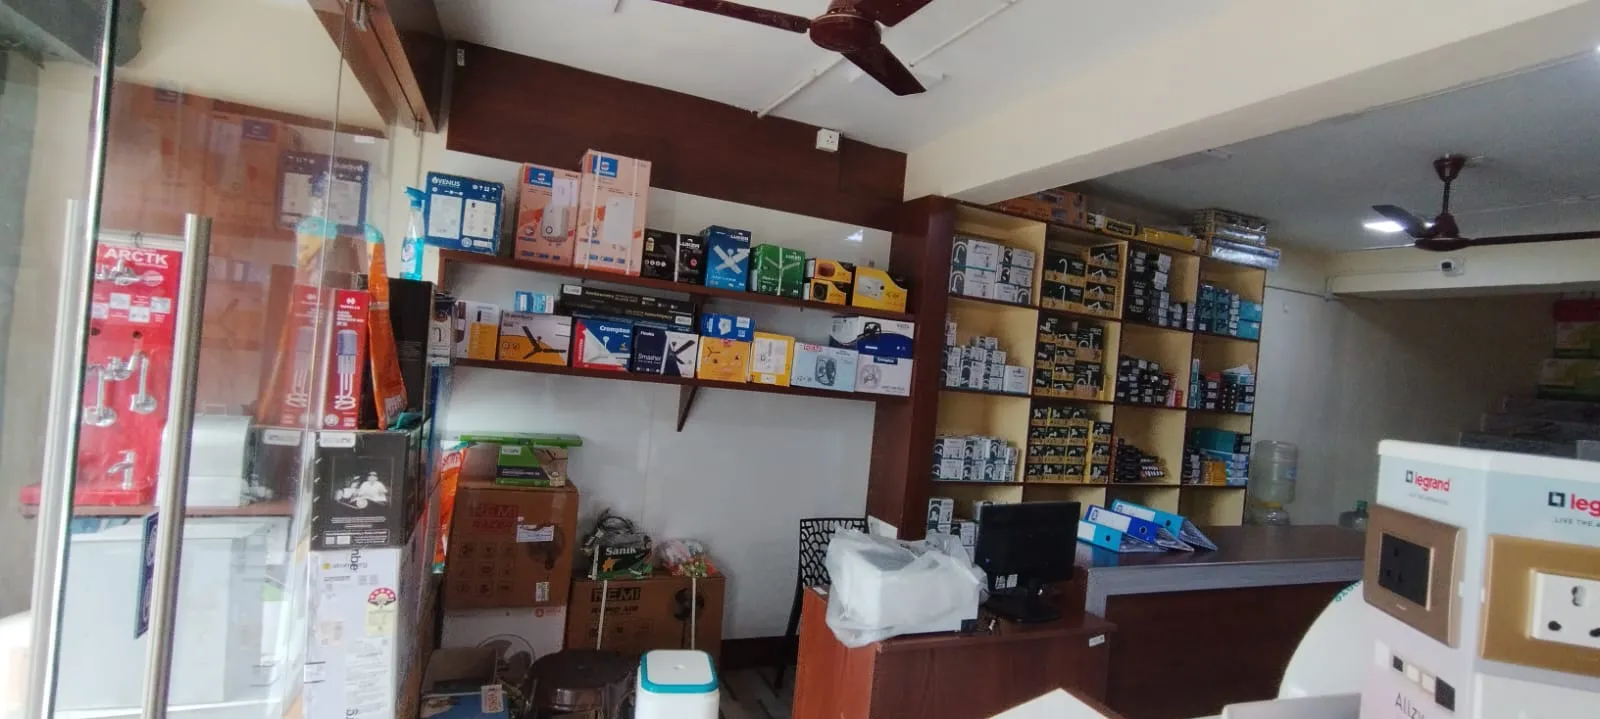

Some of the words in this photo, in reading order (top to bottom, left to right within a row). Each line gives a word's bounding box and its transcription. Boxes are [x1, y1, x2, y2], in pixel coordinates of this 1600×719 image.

[438, 178, 461, 188] VENUS
[103, 247, 169, 266] ARCTK
[600, 325, 631, 335] Crompton
[1415, 472, 1451, 492] legrand
[474, 504, 518, 518] REMI
[591, 587, 641, 602] REMI
